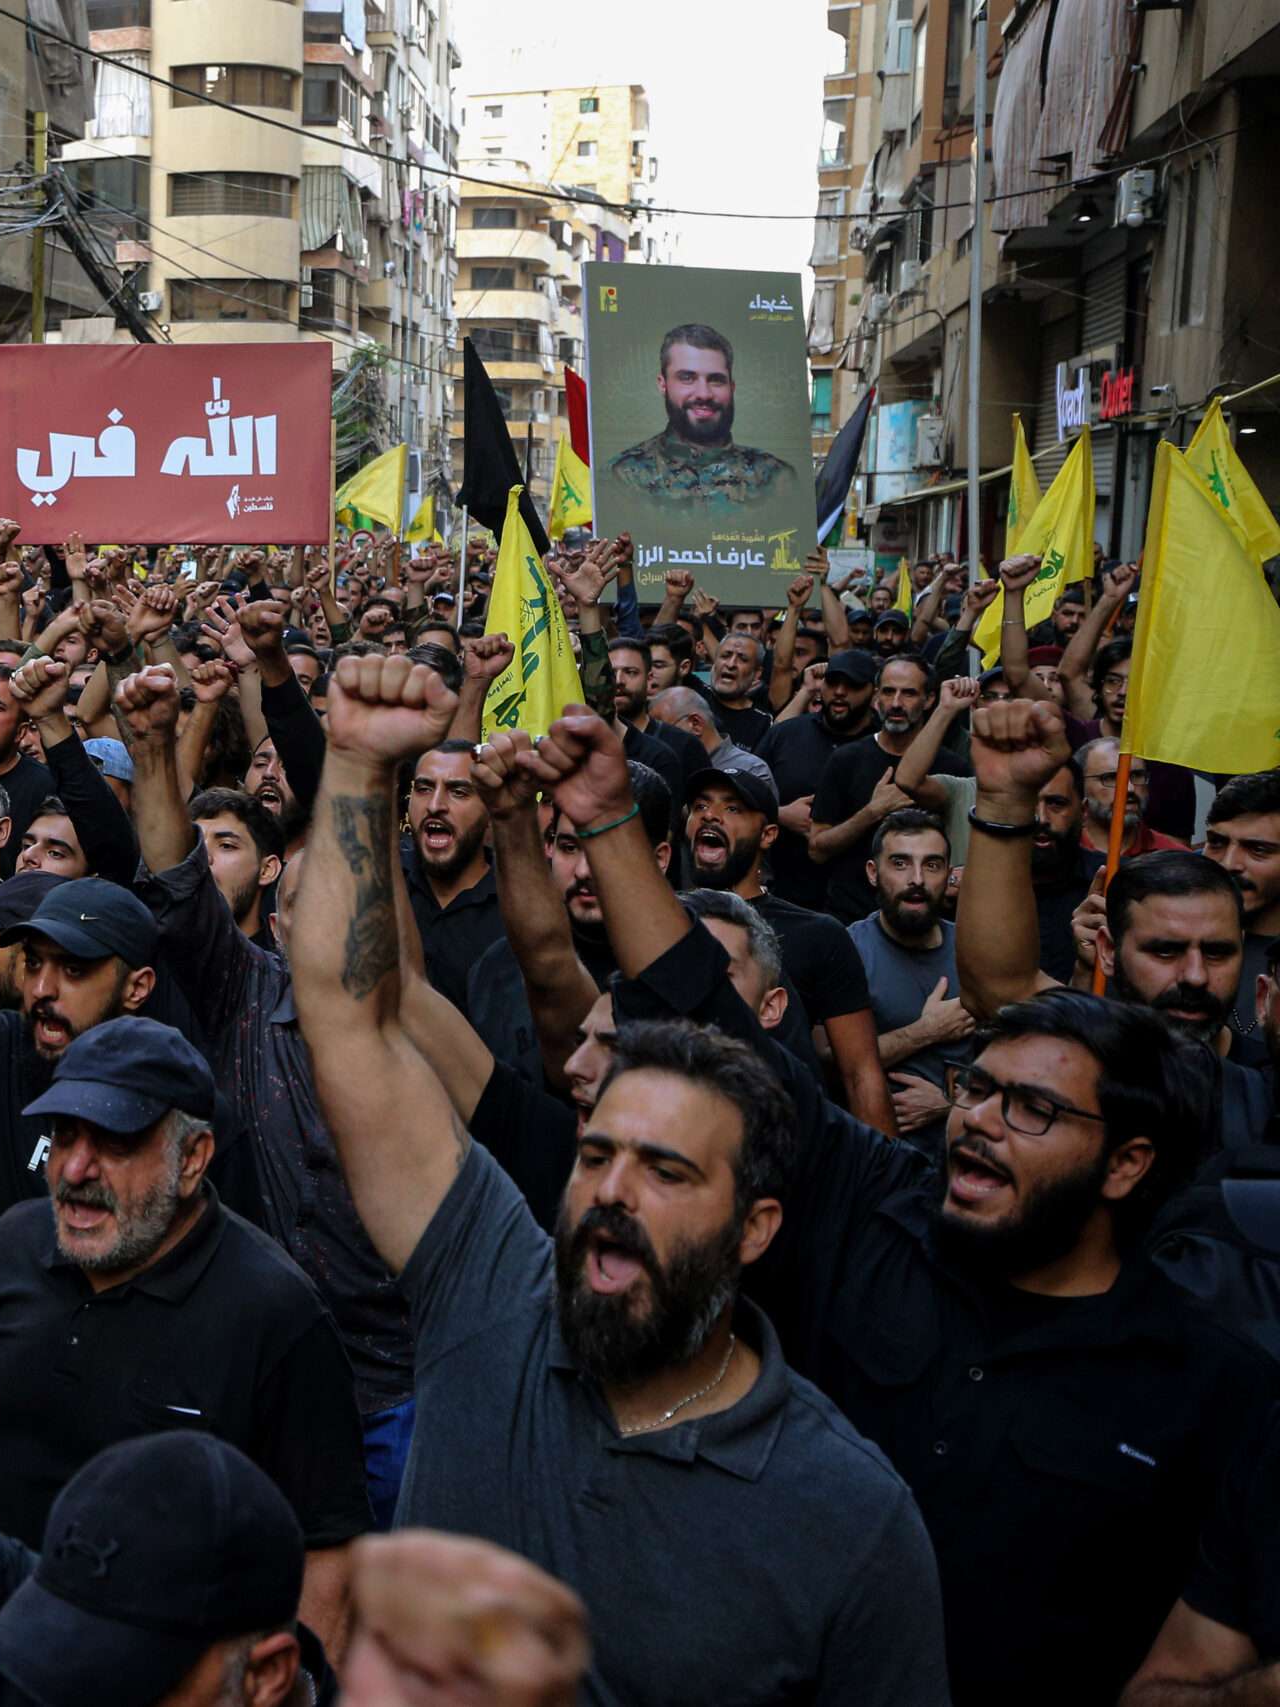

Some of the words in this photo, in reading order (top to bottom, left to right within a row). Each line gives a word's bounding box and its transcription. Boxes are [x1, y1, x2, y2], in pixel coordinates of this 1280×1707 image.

[160, 377, 277, 476] الله
[16, 408, 136, 507] في
[243, 501, 274, 513] فلسطين
[637, 544, 663, 567] الرز
[668, 544, 712, 565] أحمد
[717, 547, 766, 570] عارف
